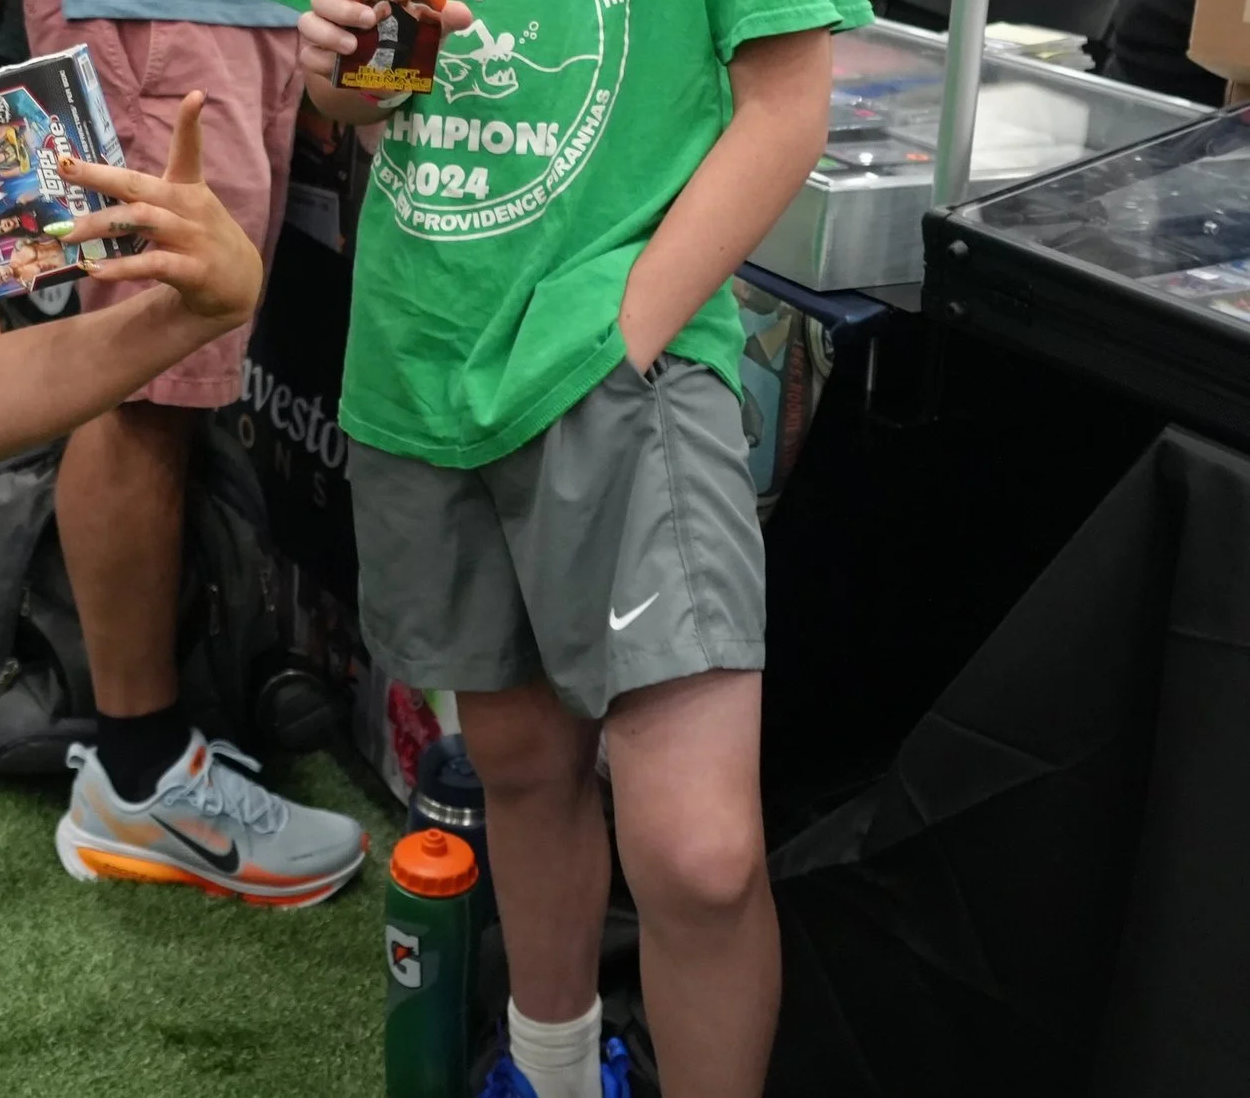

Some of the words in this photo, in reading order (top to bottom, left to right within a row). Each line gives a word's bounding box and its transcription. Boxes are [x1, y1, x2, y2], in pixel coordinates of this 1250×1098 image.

[51, 121, 90, 218] Chme
[379, 166, 404, 193] BY
[413, 185, 548, 232] PROVIDENCE
[545, 88, 611, 192] PIRANHAS
[384, 110, 560, 158] HMPIONS
[406, 159, 490, 201] 2024
